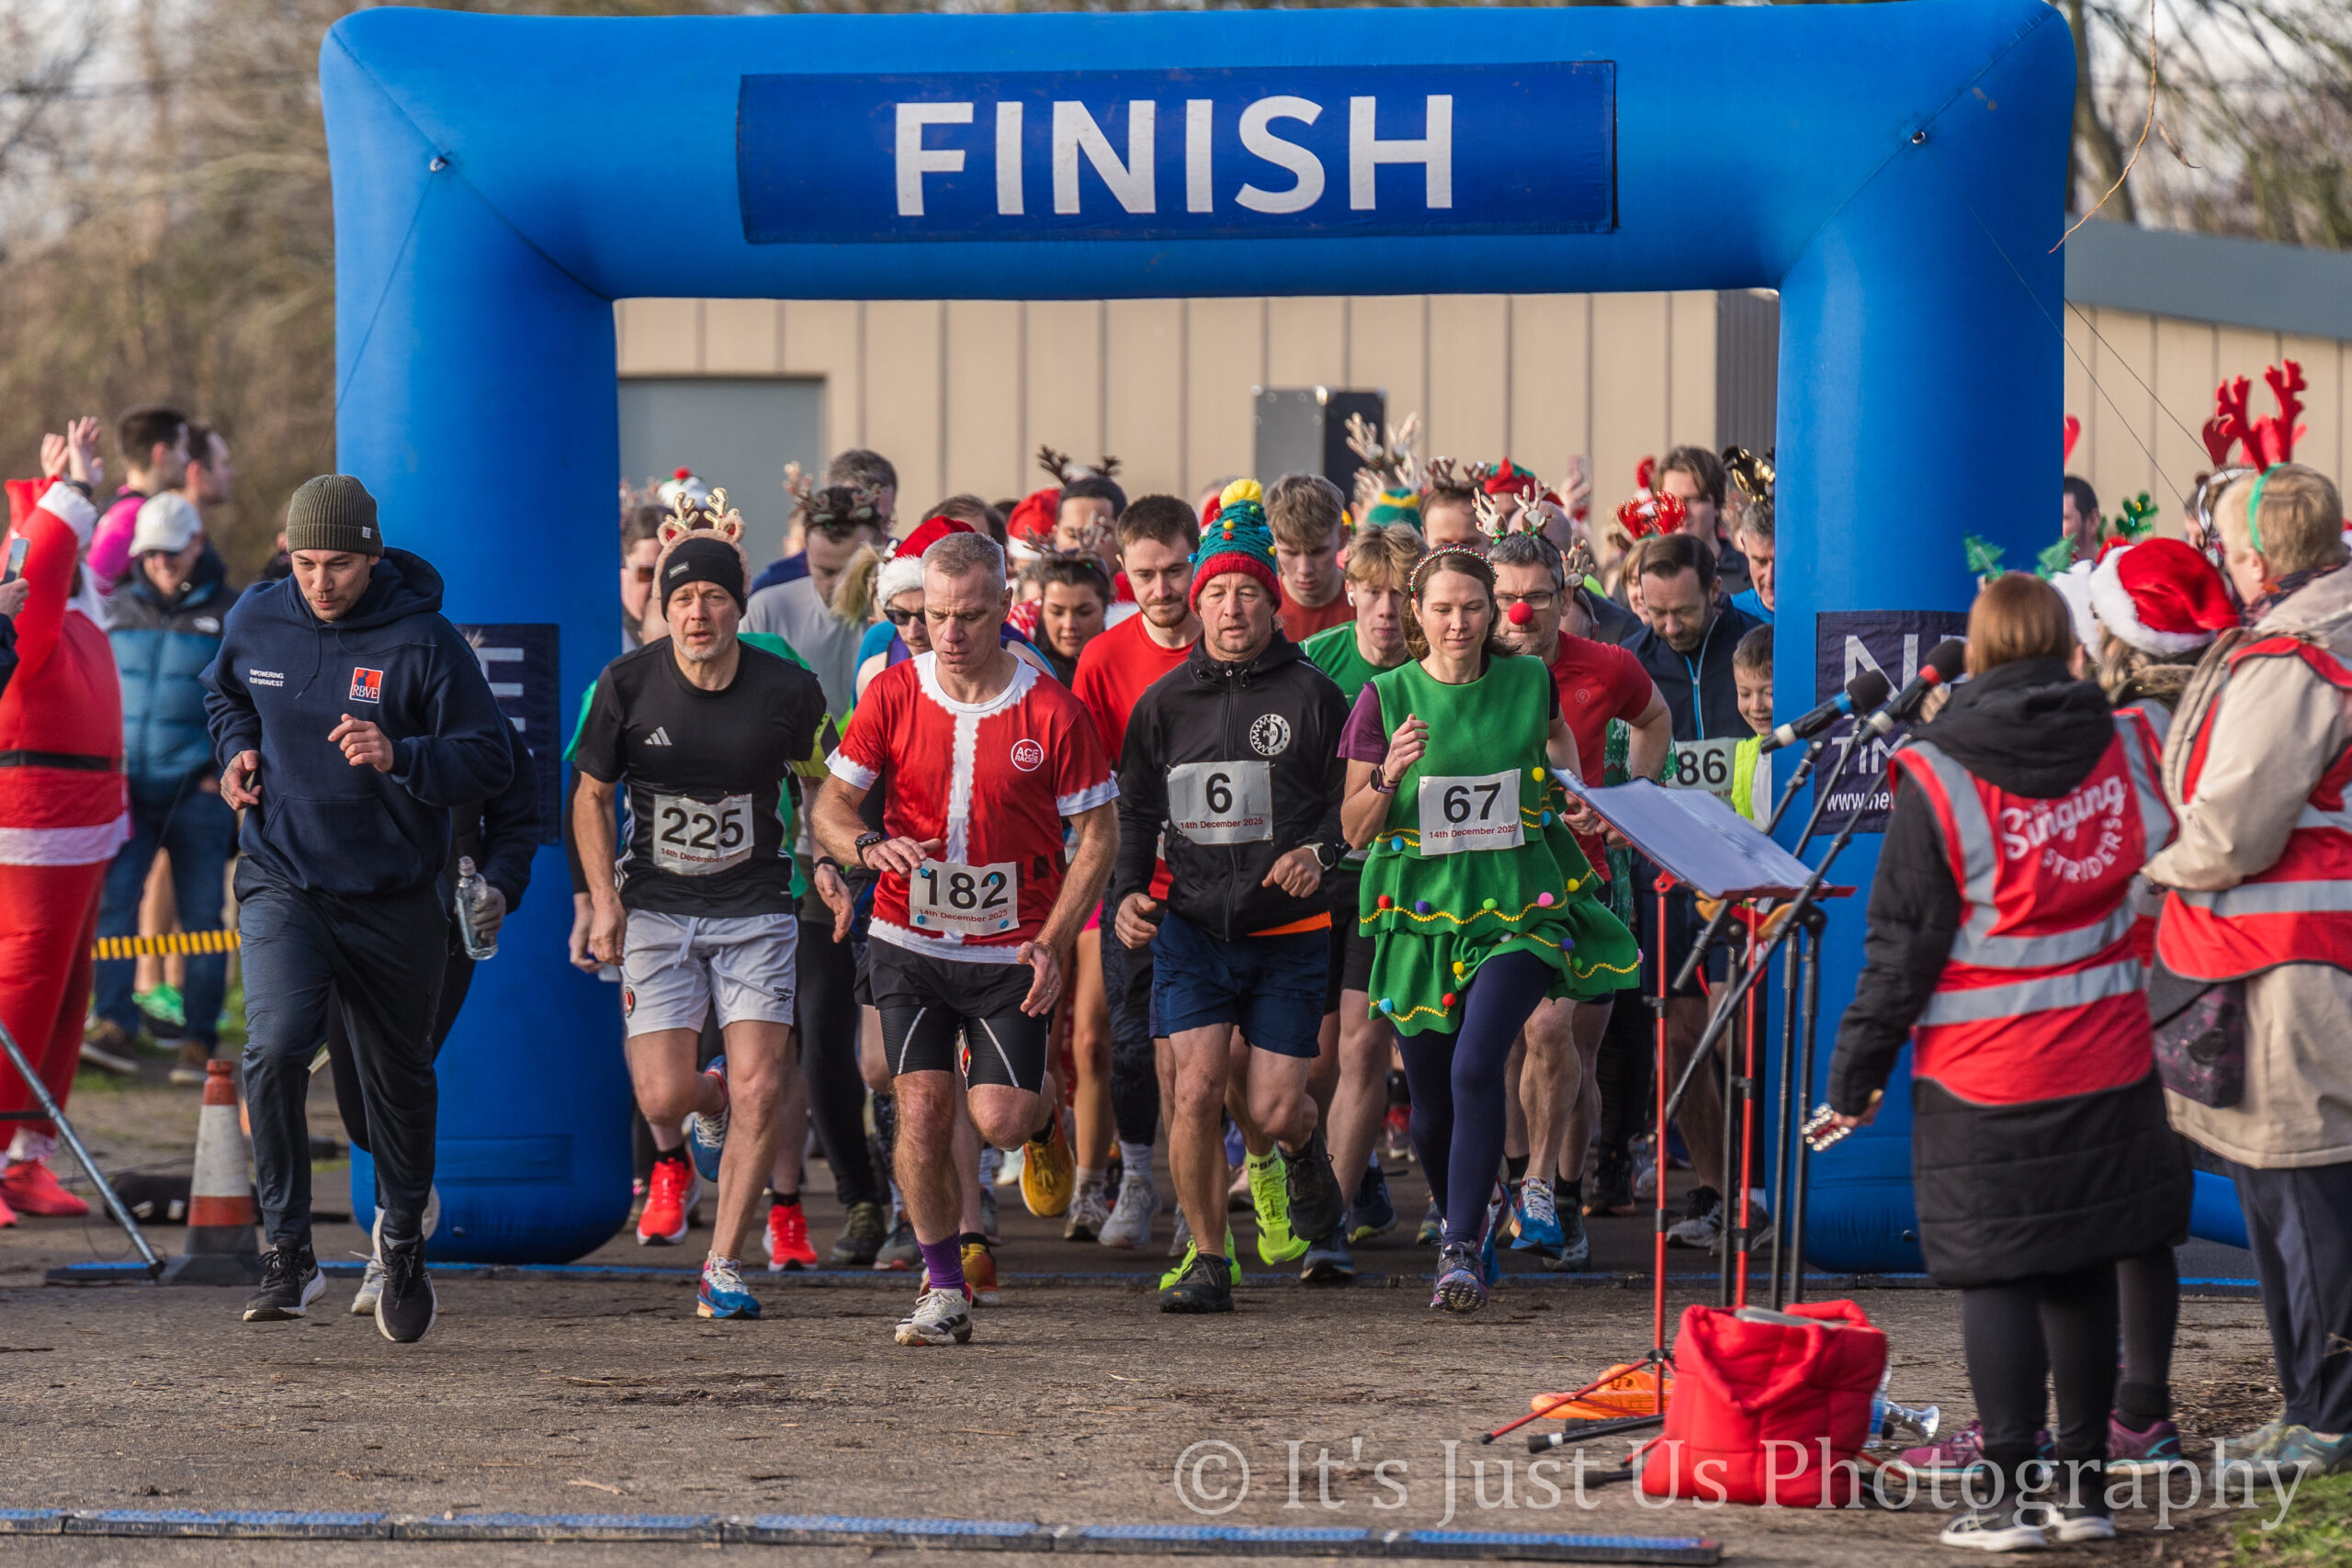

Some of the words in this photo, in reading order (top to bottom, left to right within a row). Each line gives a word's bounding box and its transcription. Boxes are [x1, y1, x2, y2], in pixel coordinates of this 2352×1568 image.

[894, 94, 1453, 217] FINISH
[352, 683, 379, 699] RBVE
[1014, 754, 1038, 764] RACES
[1015, 746, 1039, 758] ACE
[1676, 747, 1728, 785] 86
[1205, 772, 1233, 814] 6
[1442, 781, 1501, 824] 67
[661, 806, 744, 851] 225
[1180, 821, 1198, 829] 14th
[1200, 819, 1242, 829] December
[1243, 817, 1263, 826] 2025
[1429, 830, 1449, 839] 14th
[1451, 828, 1496, 837] December
[1497, 824, 1517, 834] 2025
[2000, 775, 2128, 862] Singing
[661, 847, 678, 859] 14th
[680, 852, 724, 864] December
[2041, 817, 2123, 884] STRIDERS
[921, 868, 1009, 910] 182
[919, 908, 938, 918] 14th
[940, 912, 987, 923] December
[988, 908, 1008, 921] 2025
